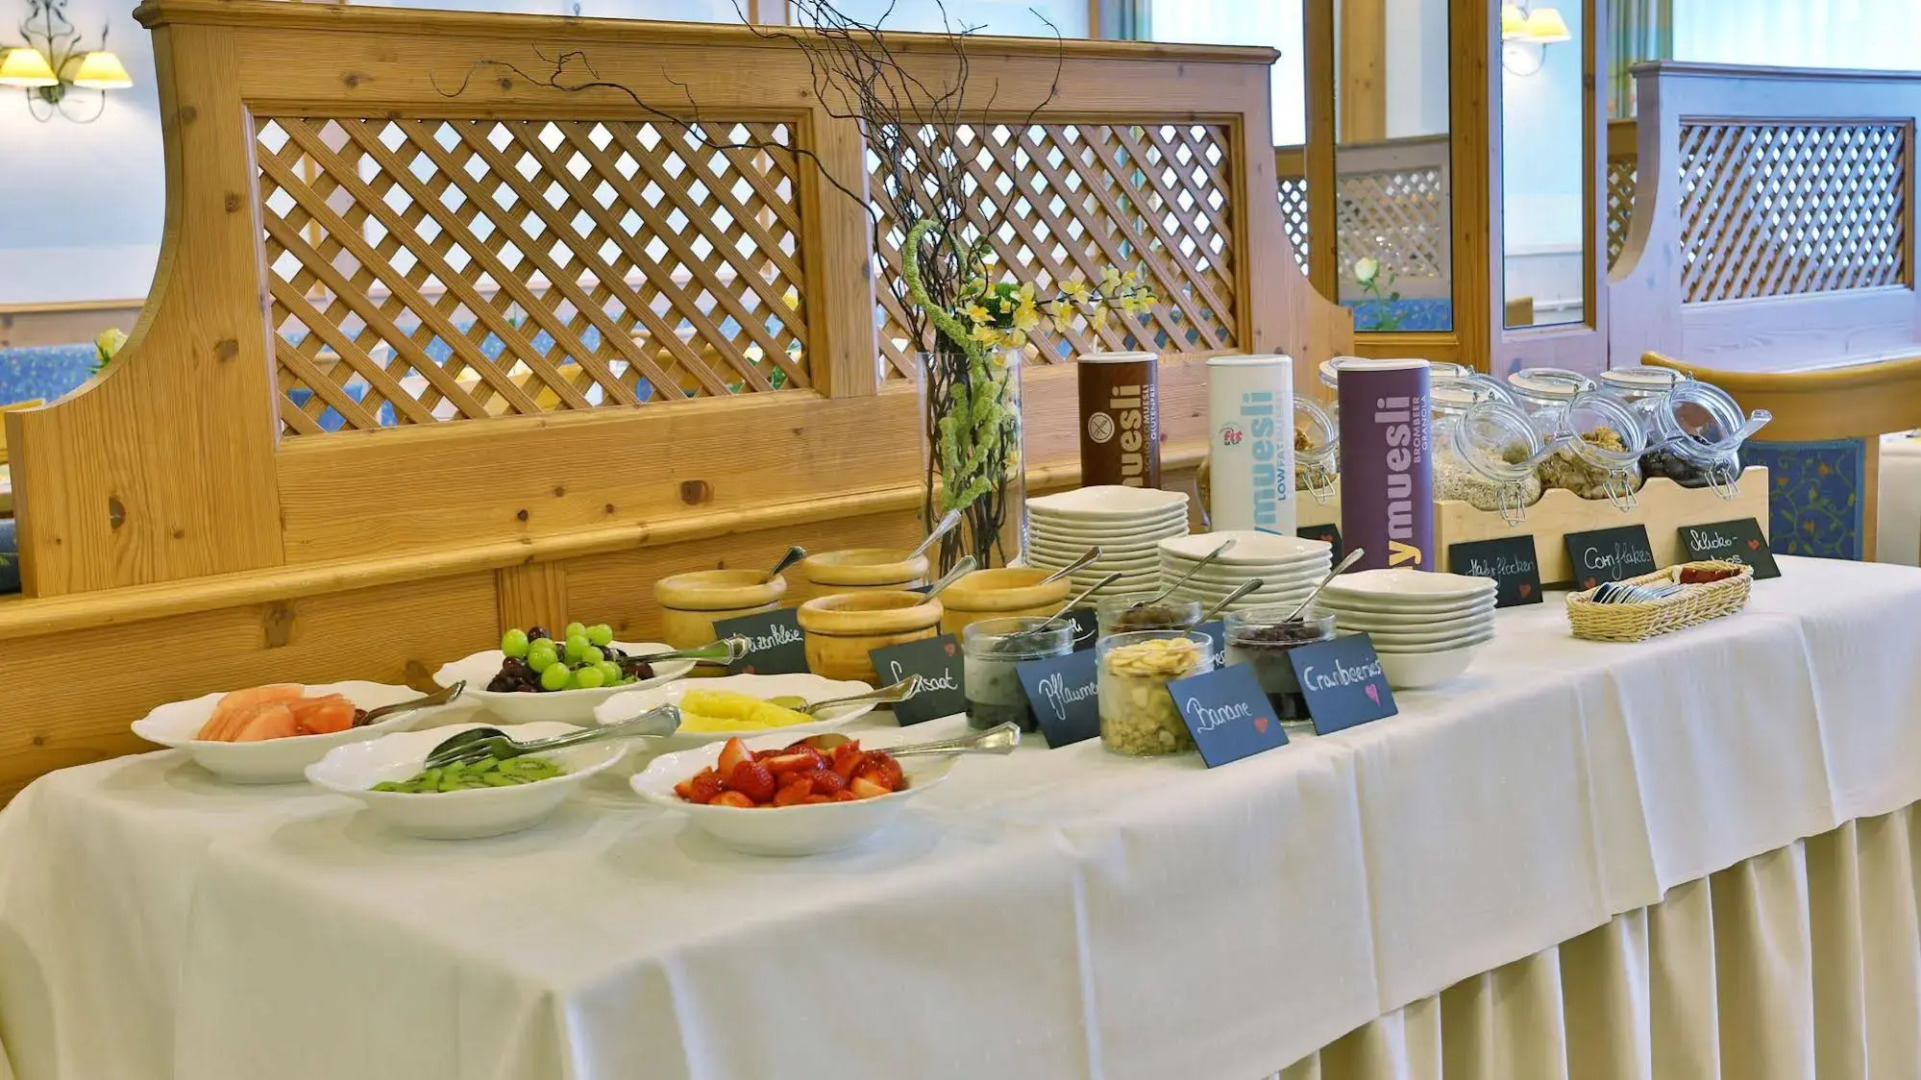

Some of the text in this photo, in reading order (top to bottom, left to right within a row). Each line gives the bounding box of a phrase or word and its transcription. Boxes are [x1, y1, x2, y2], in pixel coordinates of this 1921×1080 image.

[1110, 385, 1143, 487] uesli
[1412, 396, 1422, 464] BROMBEER
[1187, 697, 1253, 734] Banane
